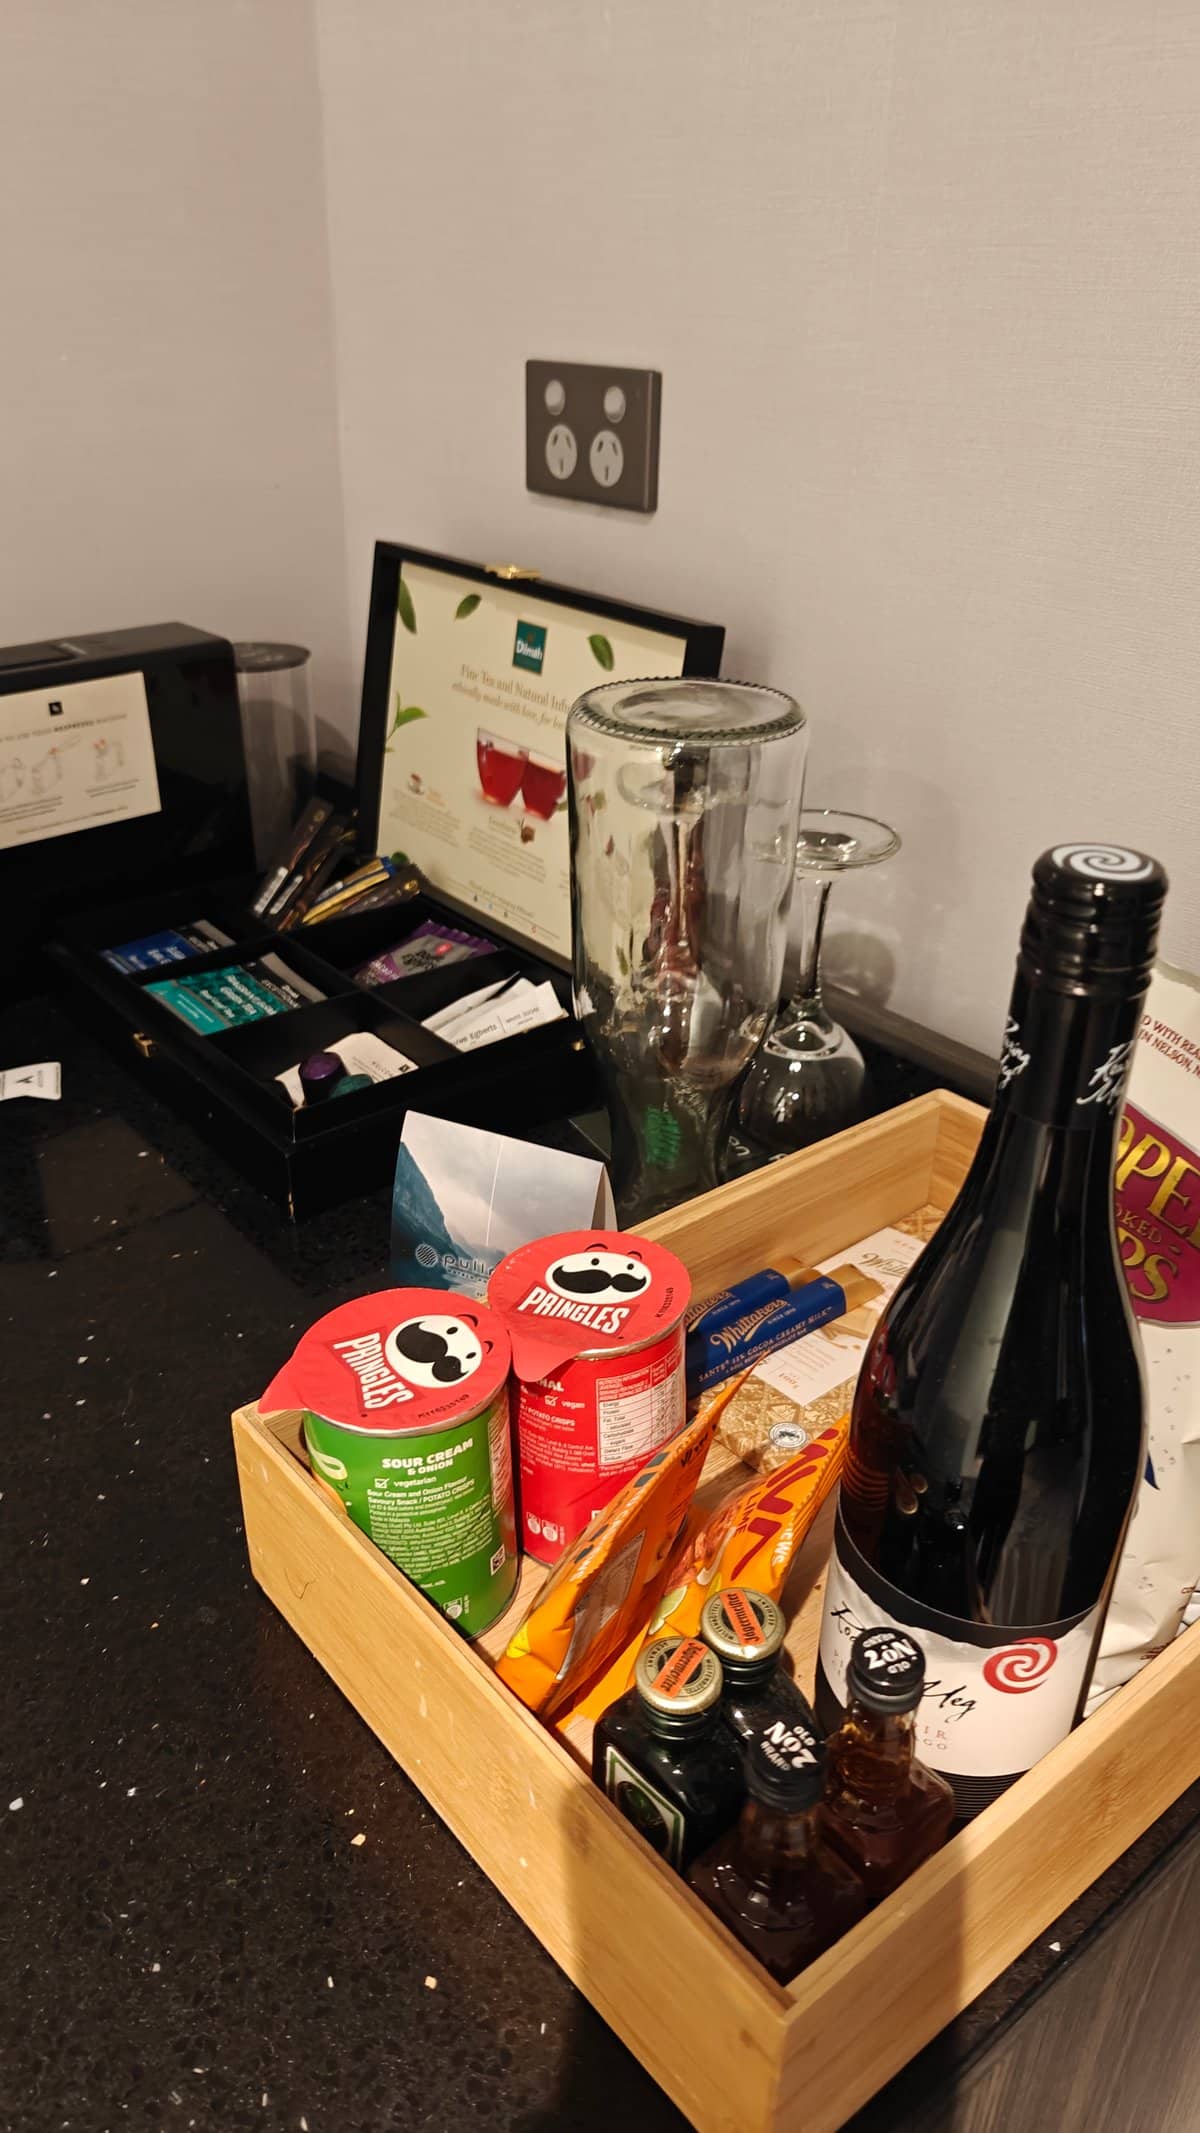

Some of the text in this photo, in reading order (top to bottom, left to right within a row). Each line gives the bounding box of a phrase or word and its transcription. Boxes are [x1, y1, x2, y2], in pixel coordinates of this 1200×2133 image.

[1153, 1020, 1183, 1046] WITH
[444, 1255, 494, 1275] pull
[518, 1287, 630, 1334] PRINGLES
[332, 1332, 415, 1409] PRINGLES
[561, 1401, 585, 1410] vegan
[382, 1438, 473, 1469] SOUR CREAM
[407, 1458, 454, 1476] & ONION
[393, 1476, 437, 1488] vegetarian
[384, 1490, 407, 1498] Cream
[423, 1490, 451, 1503] POTATO
[793, 1726, 816, 1746] OLD
[760, 1741, 791, 1771] BRAND
